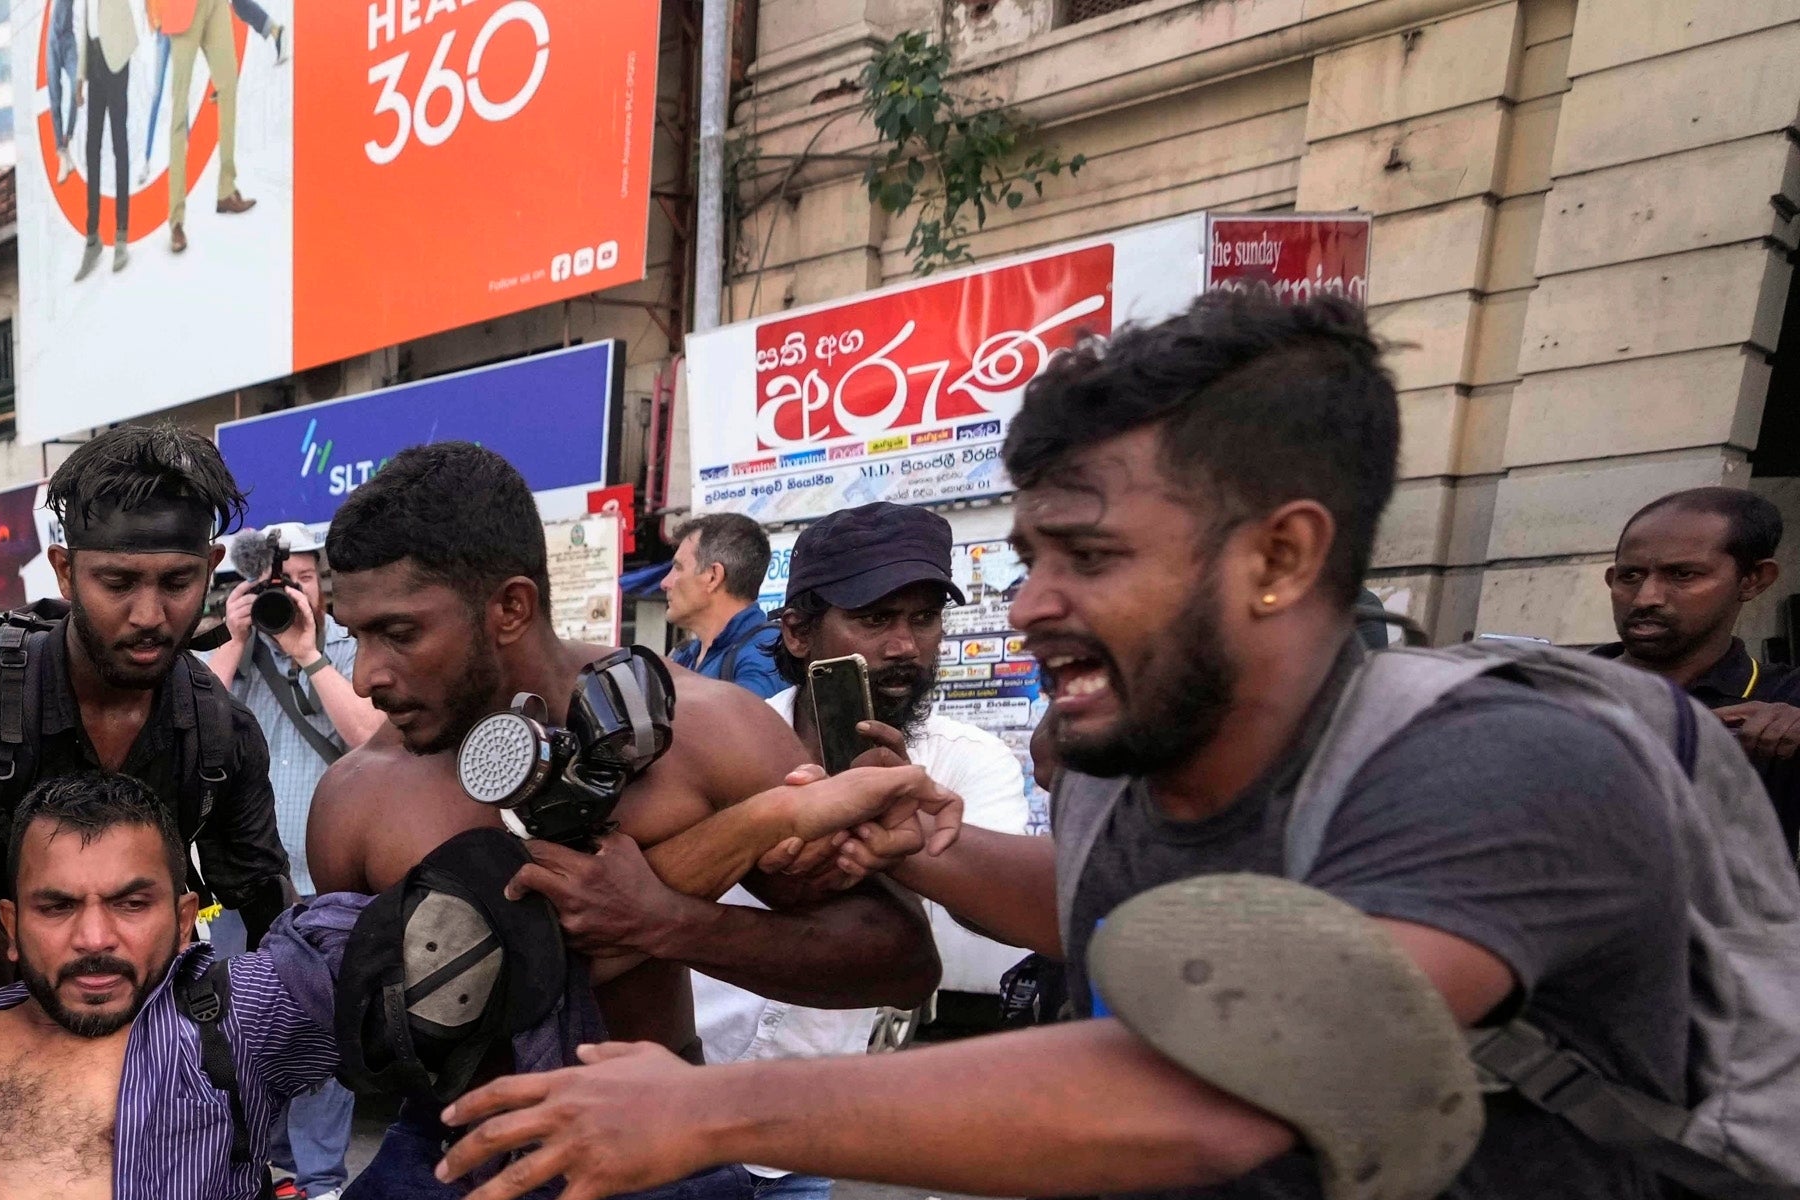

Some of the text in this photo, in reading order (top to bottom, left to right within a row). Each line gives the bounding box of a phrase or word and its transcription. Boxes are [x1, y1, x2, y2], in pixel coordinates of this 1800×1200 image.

[368, 0, 480, 51] HEA
[364, 0, 550, 165] 360
[1210, 230, 1282, 273] the sunday
[488, 276, 518, 292] Follow
[756, 328, 865, 372] සති අග
[859, 463, 894, 478] M.D.
[978, 480, 991, 489] 01
